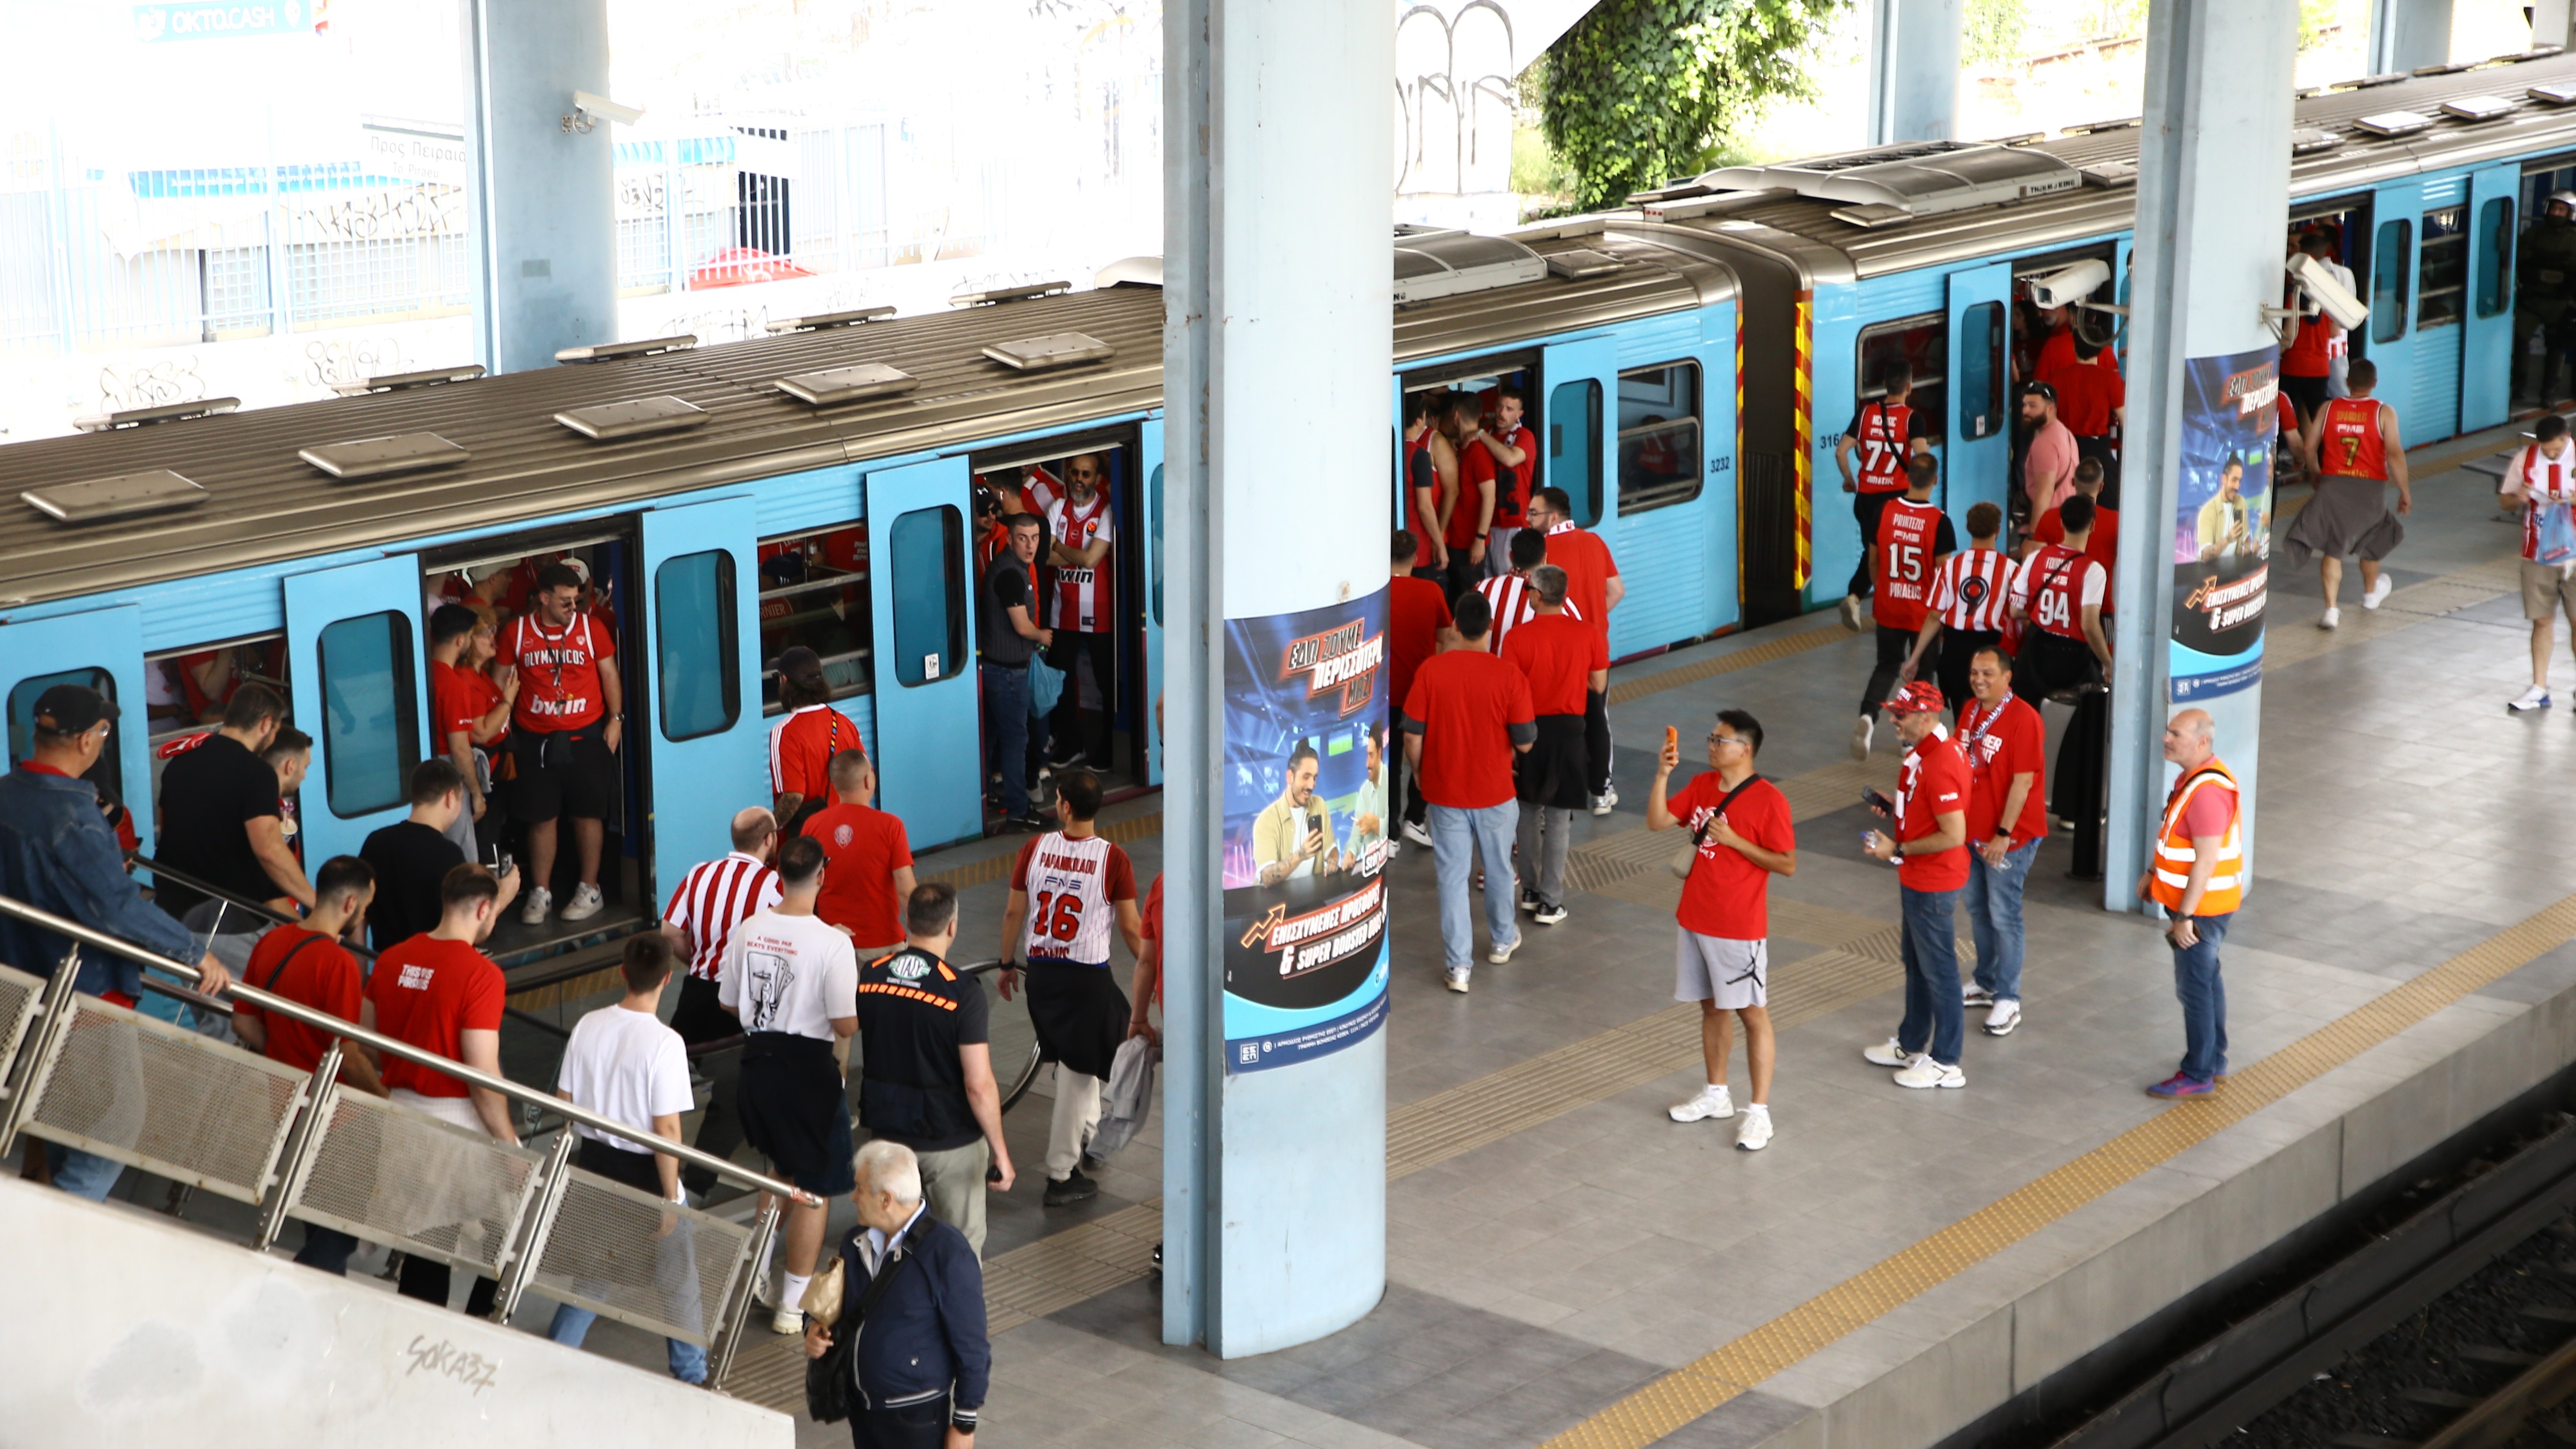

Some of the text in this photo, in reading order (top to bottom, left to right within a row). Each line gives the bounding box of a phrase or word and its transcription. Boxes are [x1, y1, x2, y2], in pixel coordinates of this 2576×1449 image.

[171, 5, 275, 34] OKTO.CASH
[372, 136, 404, 158] Προς
[393, 162, 403, 174] To
[2337, 423, 2365, 433] FMS
[1820, 433, 1841, 449] 316
[2340, 436, 2360, 467] 7
[1711, 457, 1730, 474] 3232
[1865, 439, 1904, 475] 77
[1893, 529, 1920, 543] FMS
[1889, 542, 1922, 582] 15
[1889, 581, 1922, 600] PIRAEUS
[2039, 588, 2070, 629] 94
[1288, 638, 1320, 670] ΕΔΩ
[530, 694, 587, 715] bwin
[1045, 876, 1082, 890] FMS
[1034, 890, 1083, 943] 16
[1272, 907, 1341, 946] ΕΝΙΣΧΥΜΕΝΕΣ
[747, 941, 798, 956] BEATS EVERYTHING
[1280, 945, 1295, 975] &
[1296, 941, 1331, 970] SUPER
[1332, 923, 1368, 959] BOOSTED
[402, 964, 421, 978] THIS
